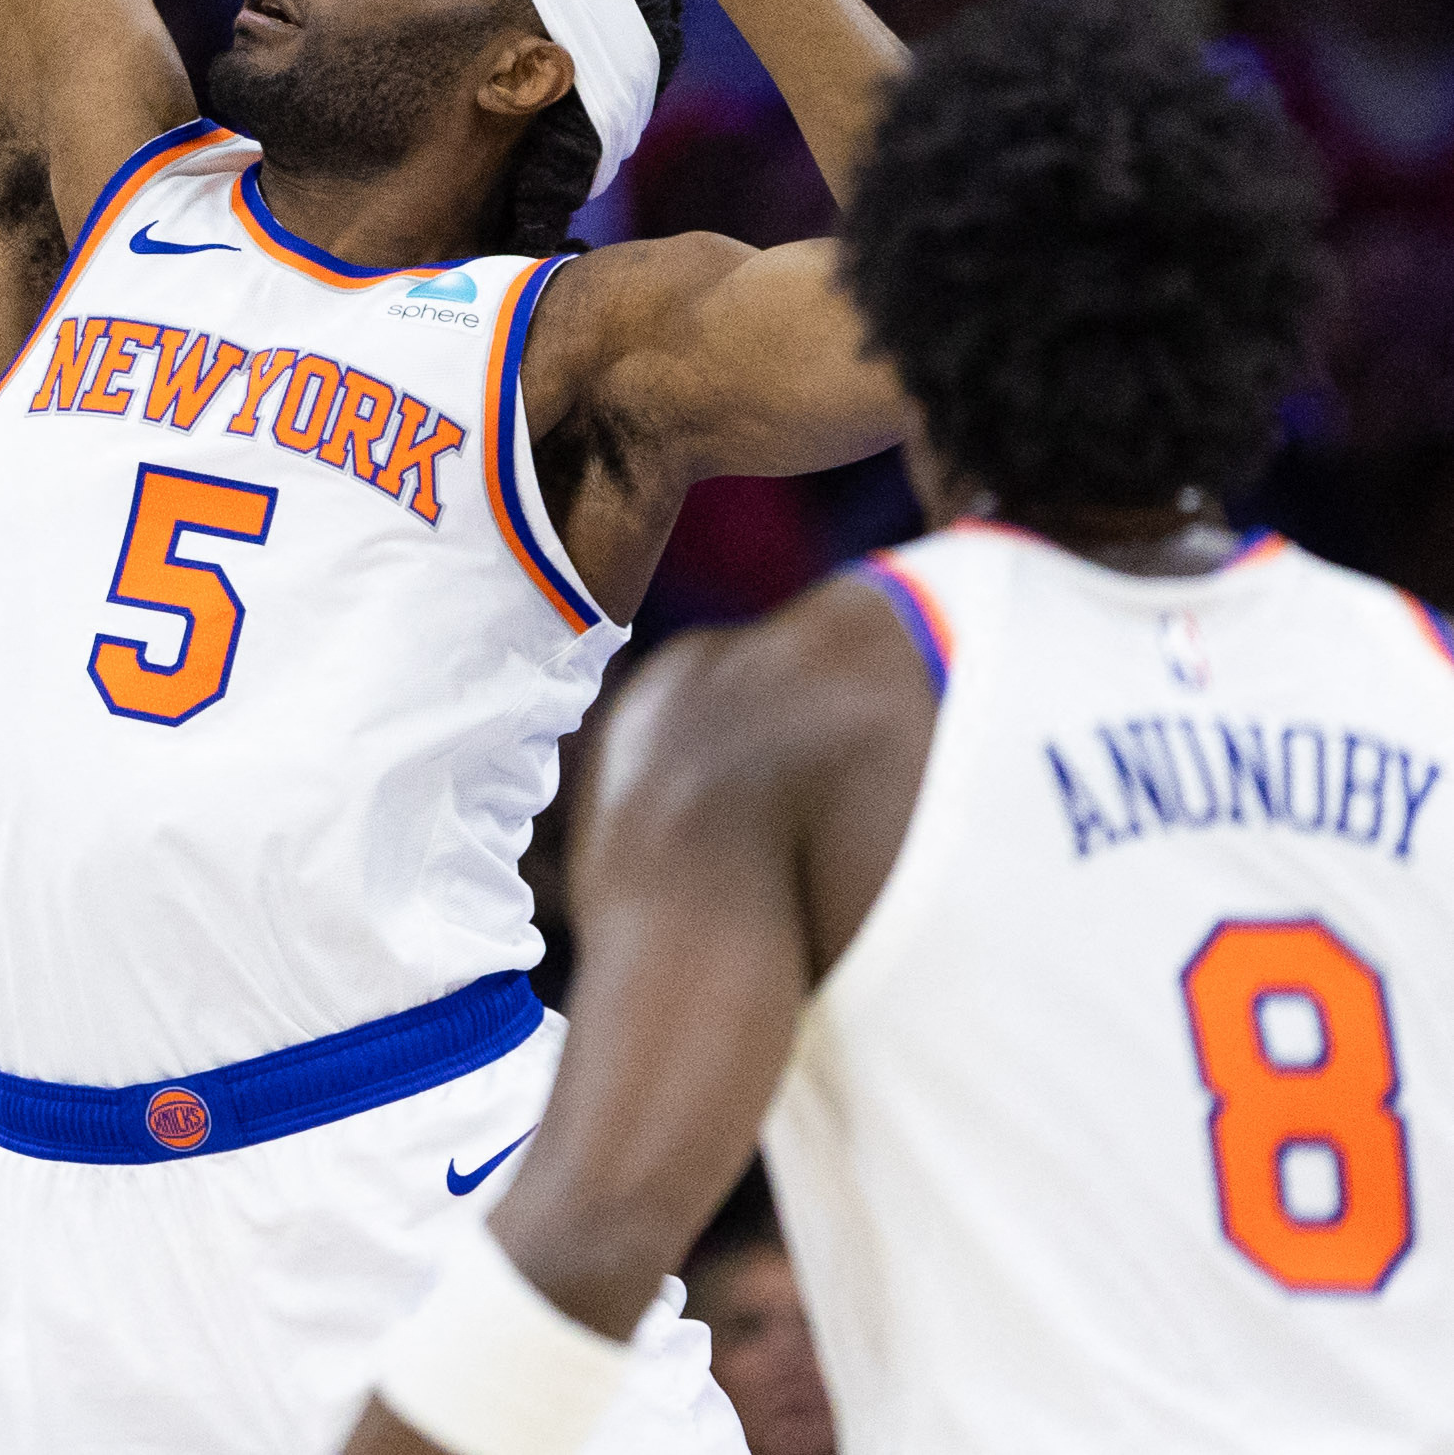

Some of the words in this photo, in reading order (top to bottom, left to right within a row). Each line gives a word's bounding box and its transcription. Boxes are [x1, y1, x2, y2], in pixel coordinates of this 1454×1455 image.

[28, 316, 247, 433] NEW
[225, 347, 469, 529] YORK
[387, 304, 480, 329] sphere
[87, 462, 279, 727] 5
[1042, 716, 1441, 857] ANUNOBY
[1180, 917, 1414, 1294] 8
